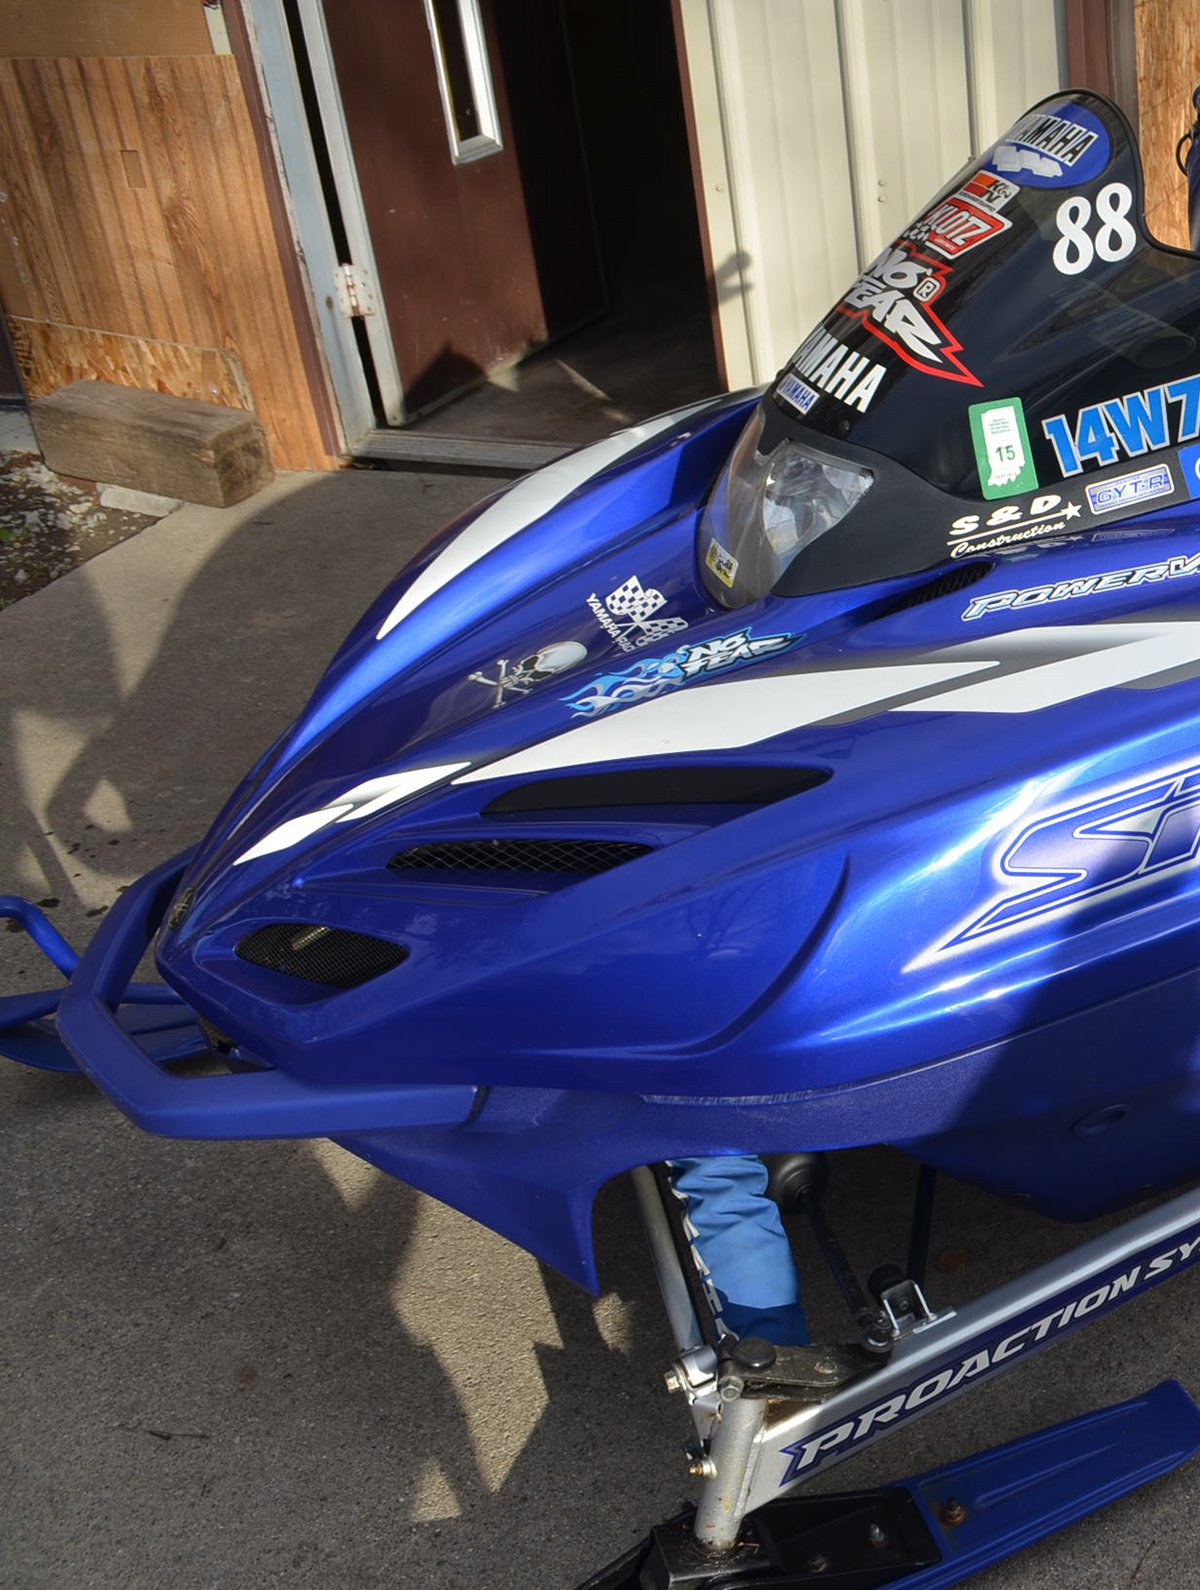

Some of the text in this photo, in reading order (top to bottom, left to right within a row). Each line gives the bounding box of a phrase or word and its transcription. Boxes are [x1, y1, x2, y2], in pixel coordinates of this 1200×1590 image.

[925, 203, 993, 246] KLOTZ
[1052, 182, 1136, 275] 88
[791, 325, 887, 413] AMAHA
[995, 445, 1016, 462] 15
[949, 494, 1061, 535] S & D
[950, 521, 1066, 558] Construction
[586, 593, 622, 638] YAMAHA
[687, 632, 747, 663] NO
[796, 1265, 1141, 1470] PROACTION
